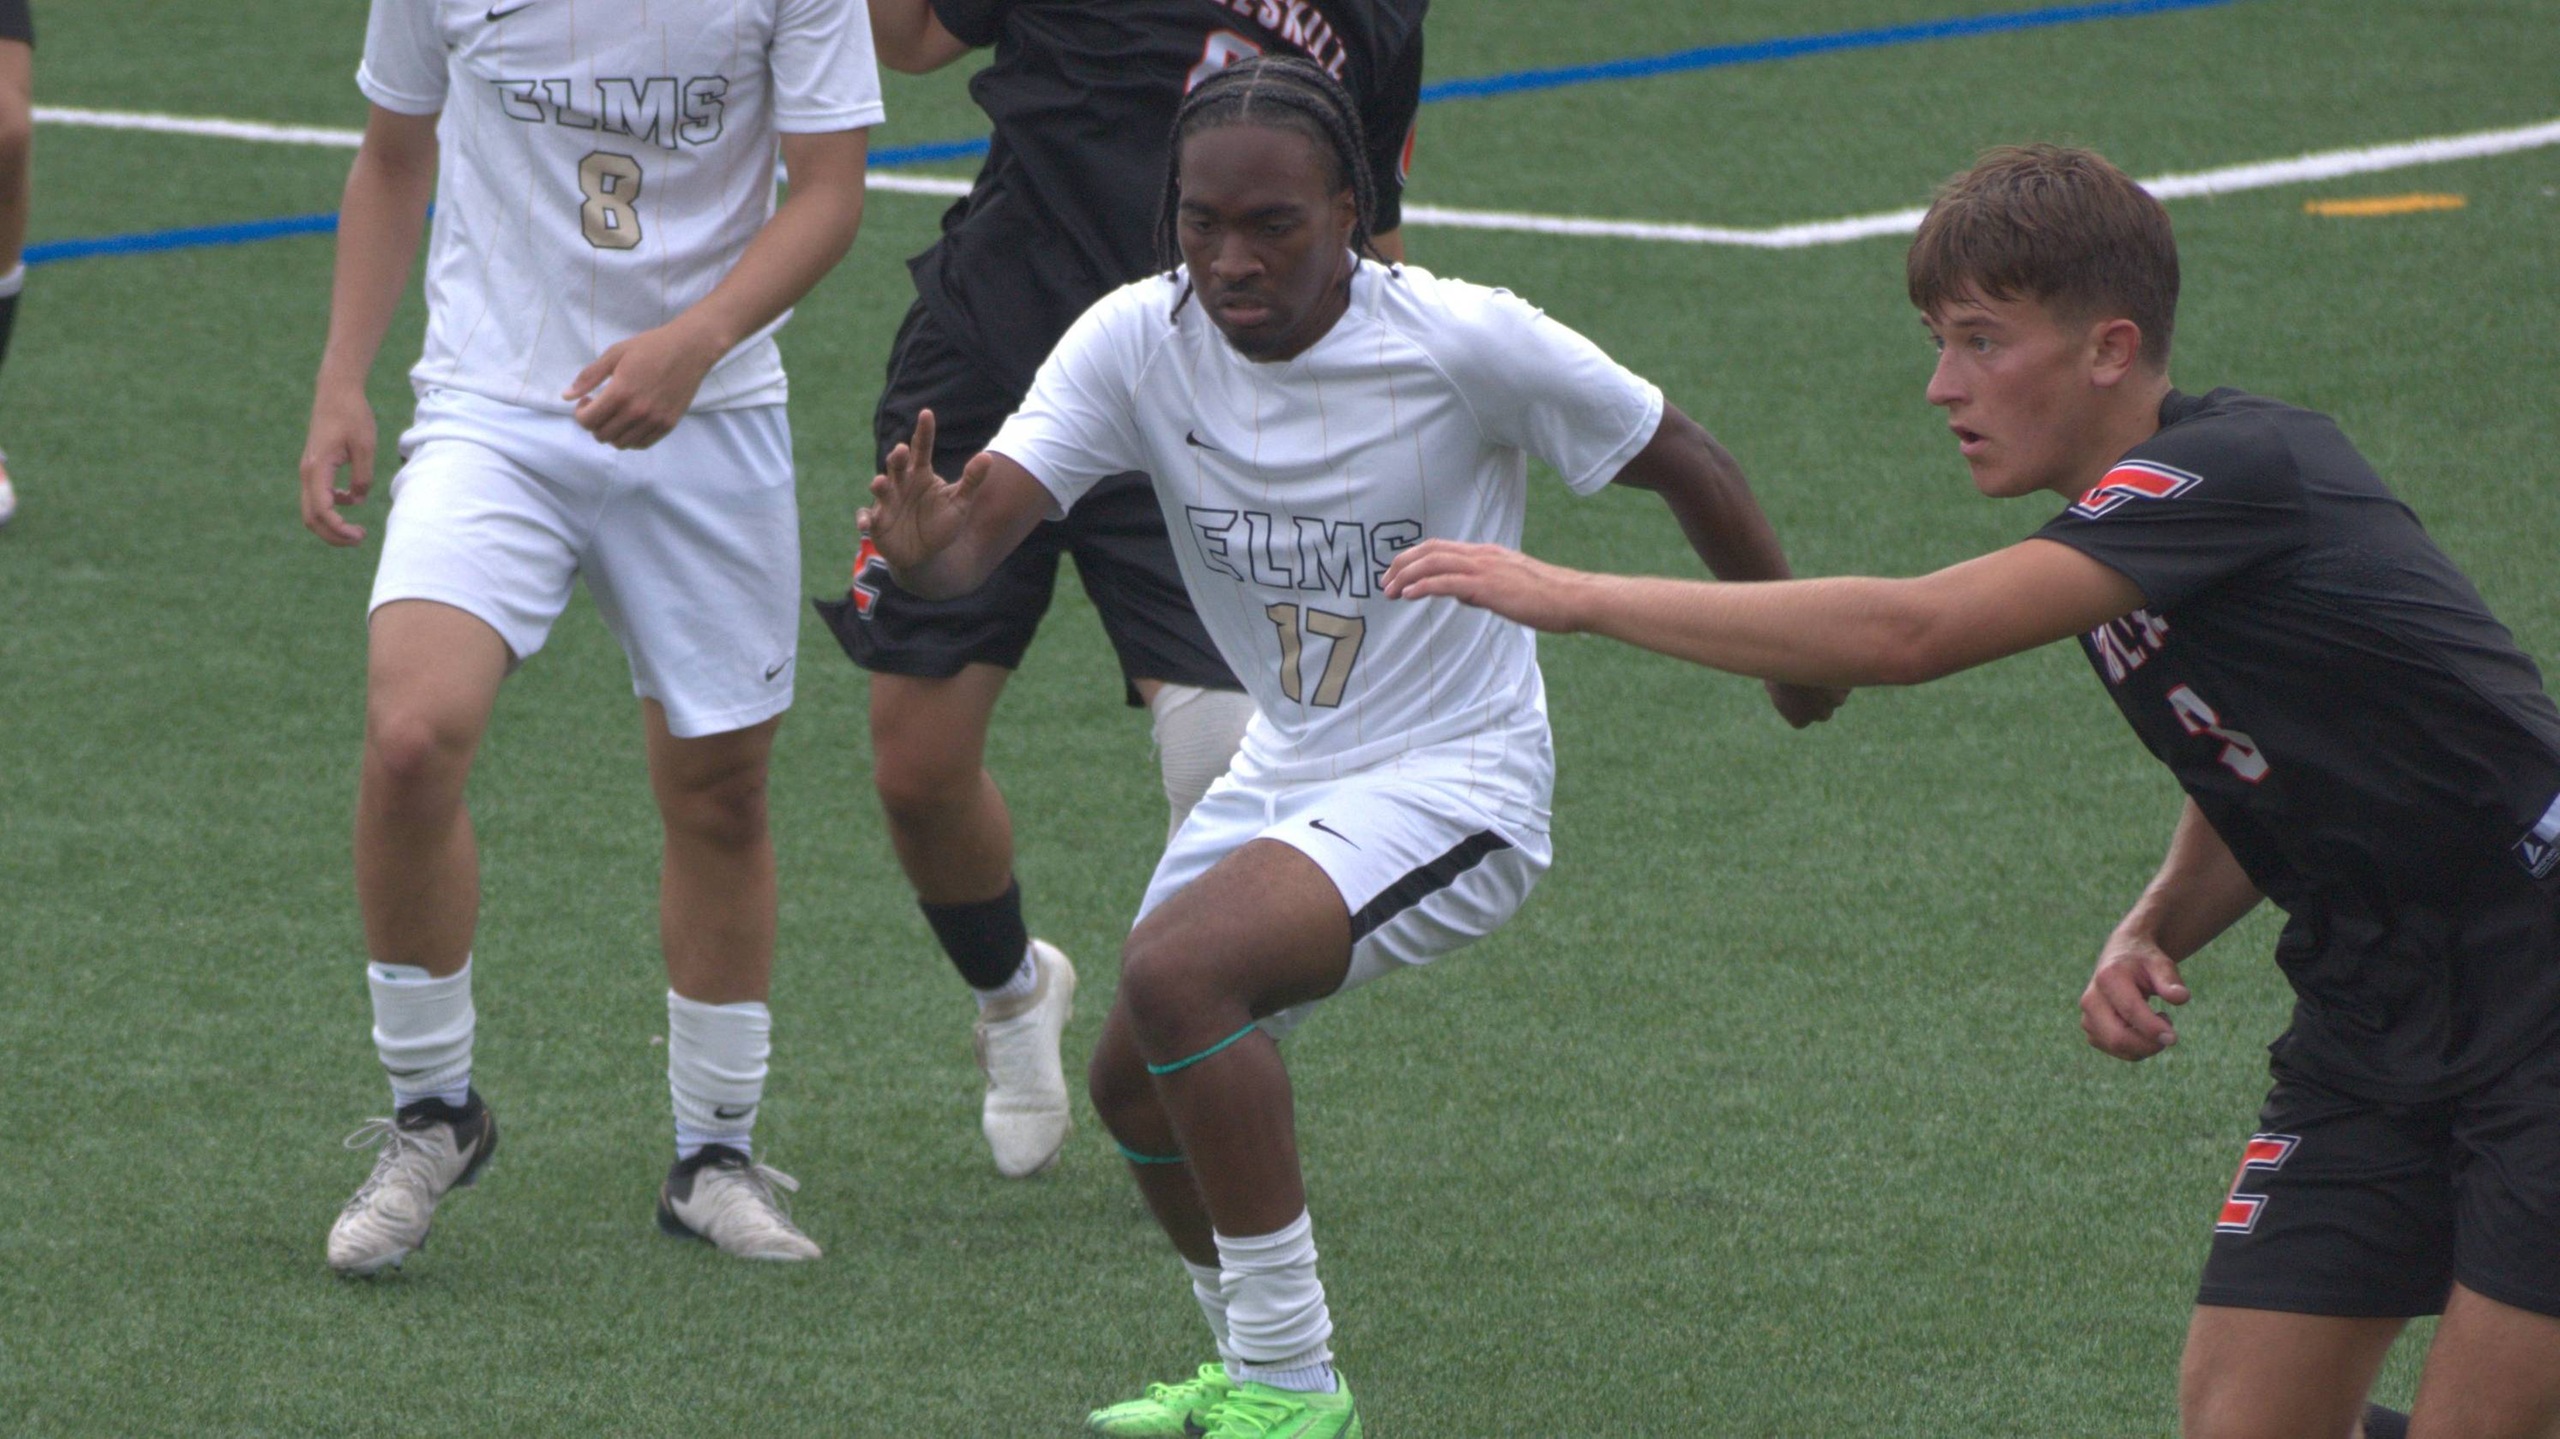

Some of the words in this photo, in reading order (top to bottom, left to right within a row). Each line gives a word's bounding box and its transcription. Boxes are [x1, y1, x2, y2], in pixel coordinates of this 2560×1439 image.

[489, 75, 729, 150] ELMS
[577, 150, 643, 250] 8
[1185, 505, 1422, 599] ELMS
[1265, 601, 1367, 709] 17
[2166, 683, 2271, 784] 3
